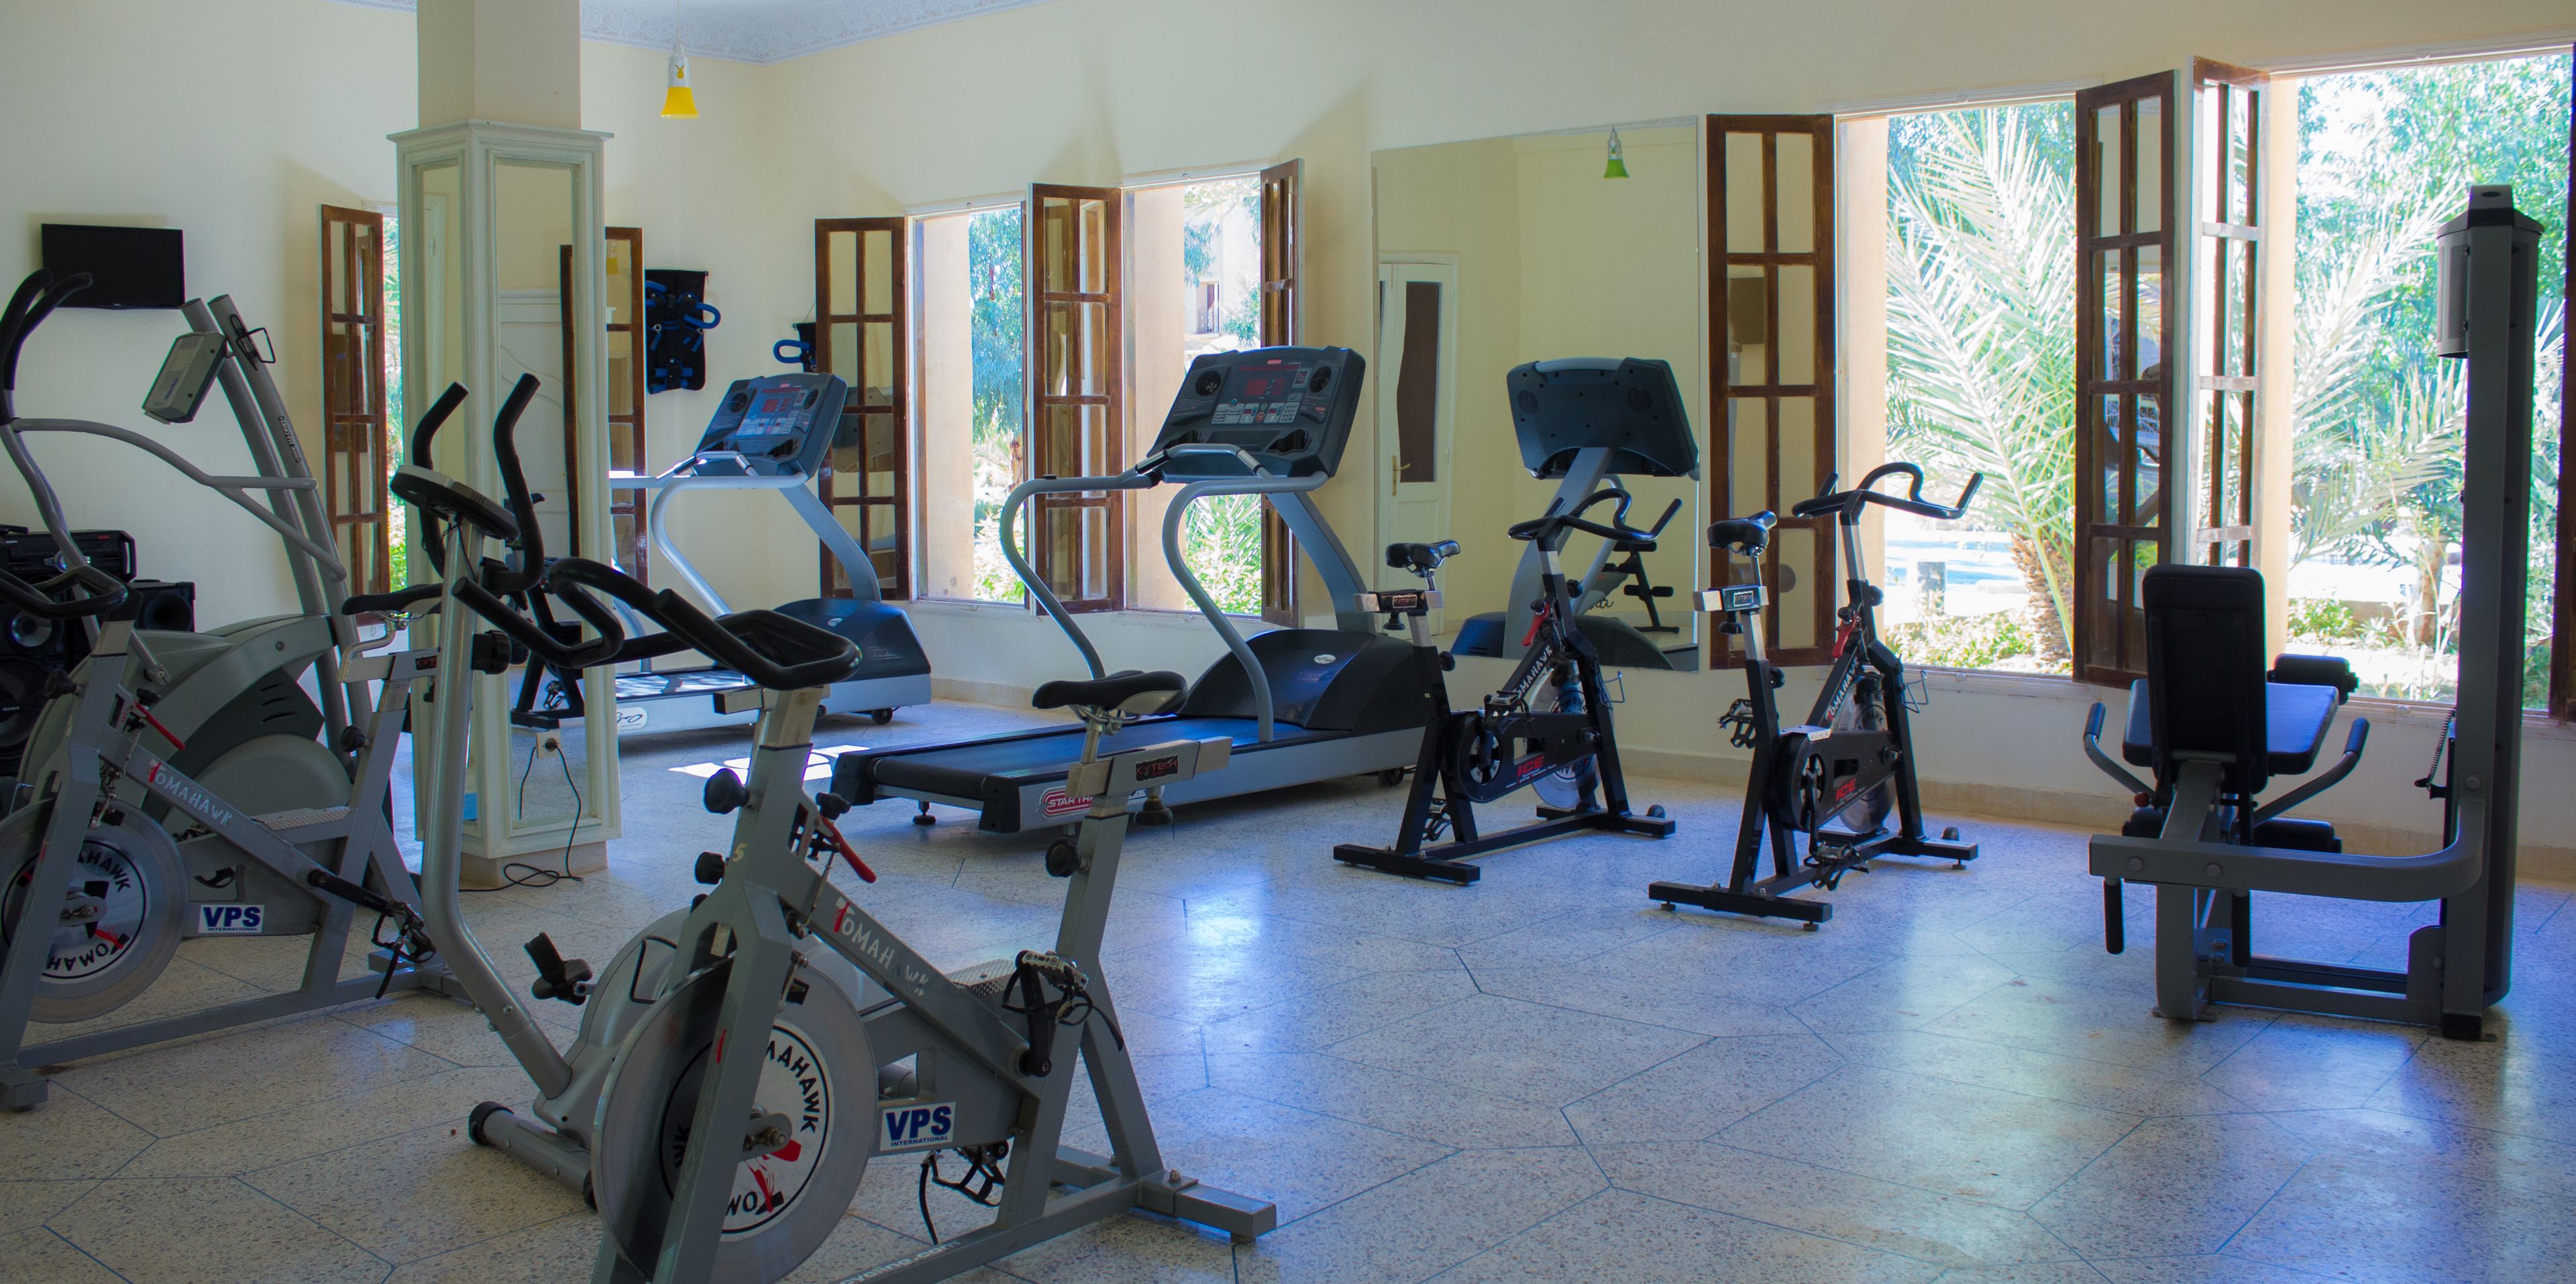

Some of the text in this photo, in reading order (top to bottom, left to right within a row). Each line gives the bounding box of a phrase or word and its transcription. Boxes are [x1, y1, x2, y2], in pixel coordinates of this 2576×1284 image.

[1137, 758, 1177, 776] CYTECH
[1517, 756, 1545, 777] ICE
[148, 759, 233, 826] TOMAHAWK
[1836, 777, 1856, 802] ICE
[733, 843, 747, 862] 5
[77, 851, 131, 893] HAWK
[203, 906, 260, 927] VPS
[833, 897, 929, 996] TOMAHWK
[765, 1040, 820, 1134] AHAWK
[886, 1106, 951, 1141] VPS
[891, 1134, 949, 1147] INTERNATIONAL
